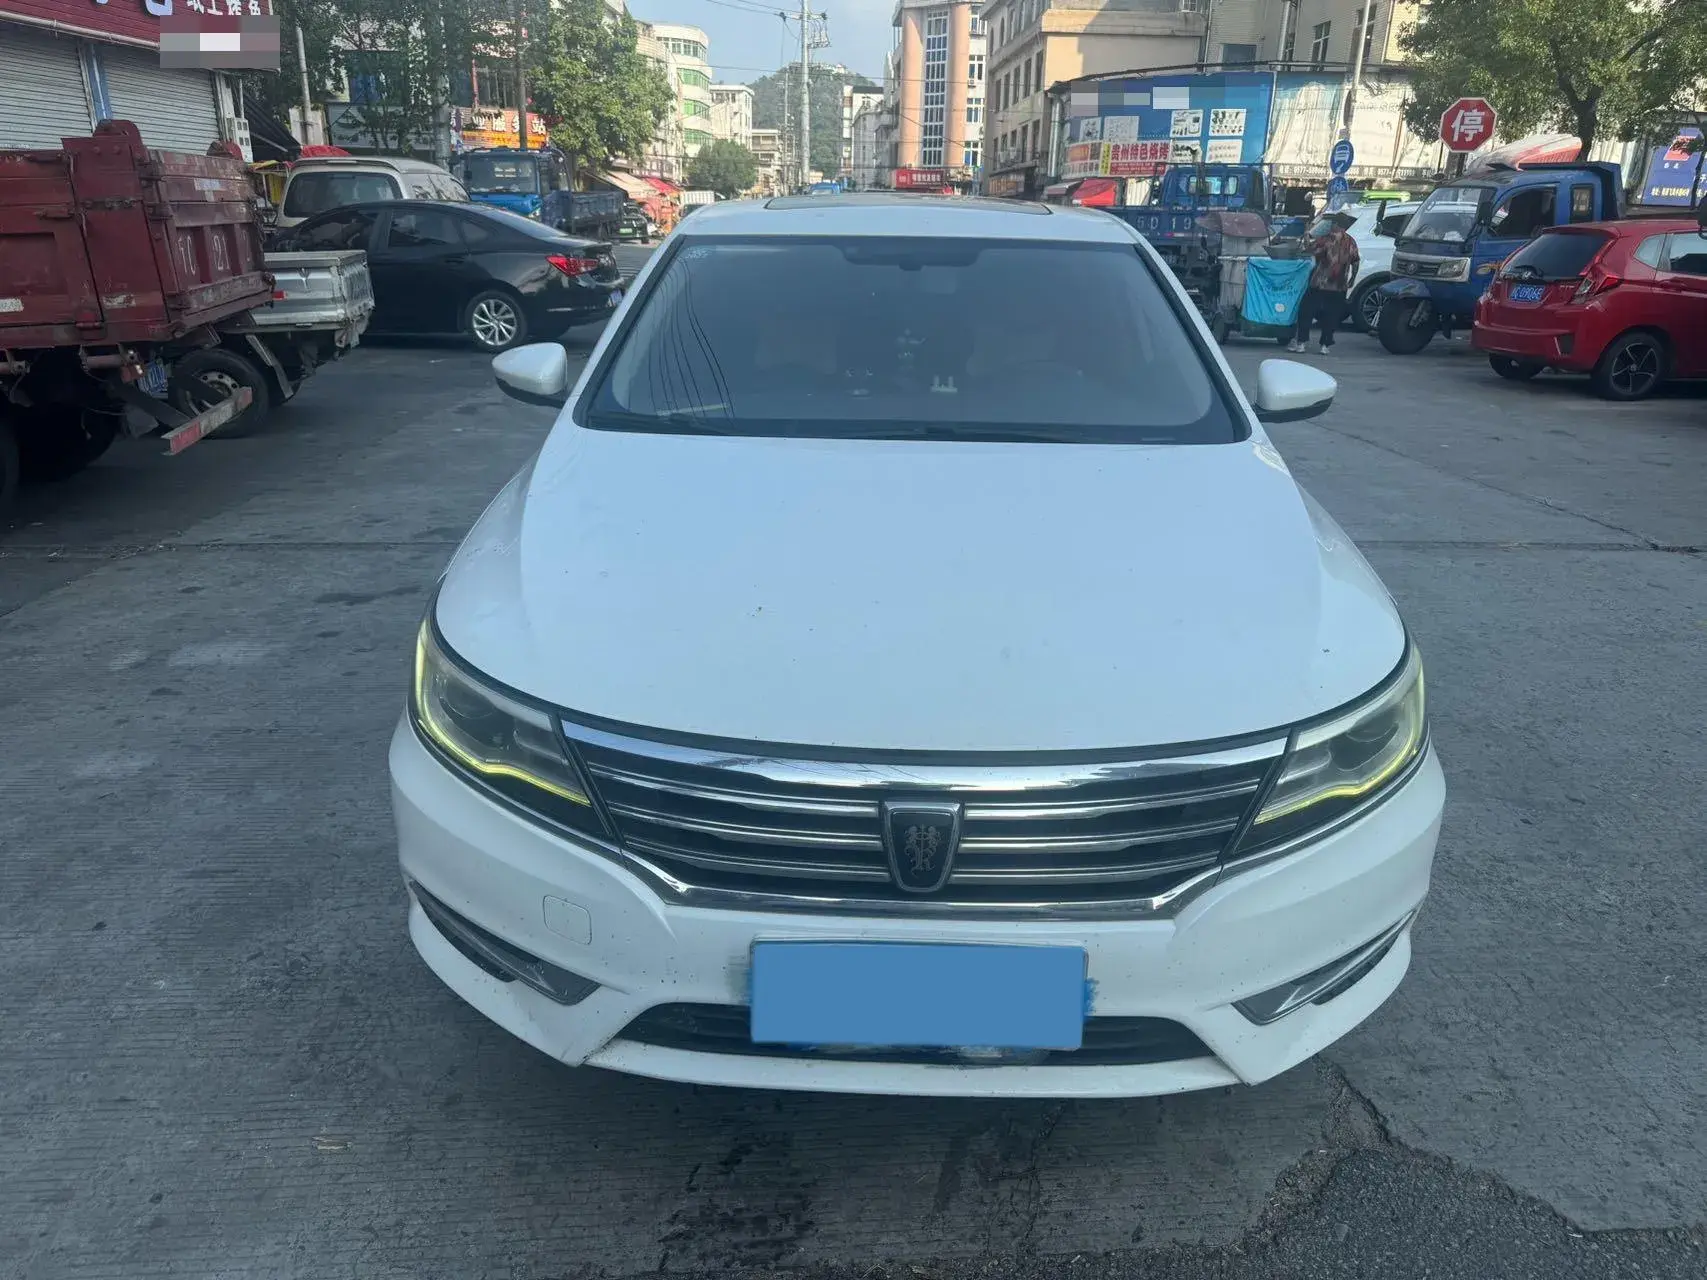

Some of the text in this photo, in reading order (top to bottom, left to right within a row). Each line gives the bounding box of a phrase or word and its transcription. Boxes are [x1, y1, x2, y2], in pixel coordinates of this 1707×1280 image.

[1451, 109, 1485, 142] 停
[1111, 142, 1169, 160] 贵州特色烧烤
